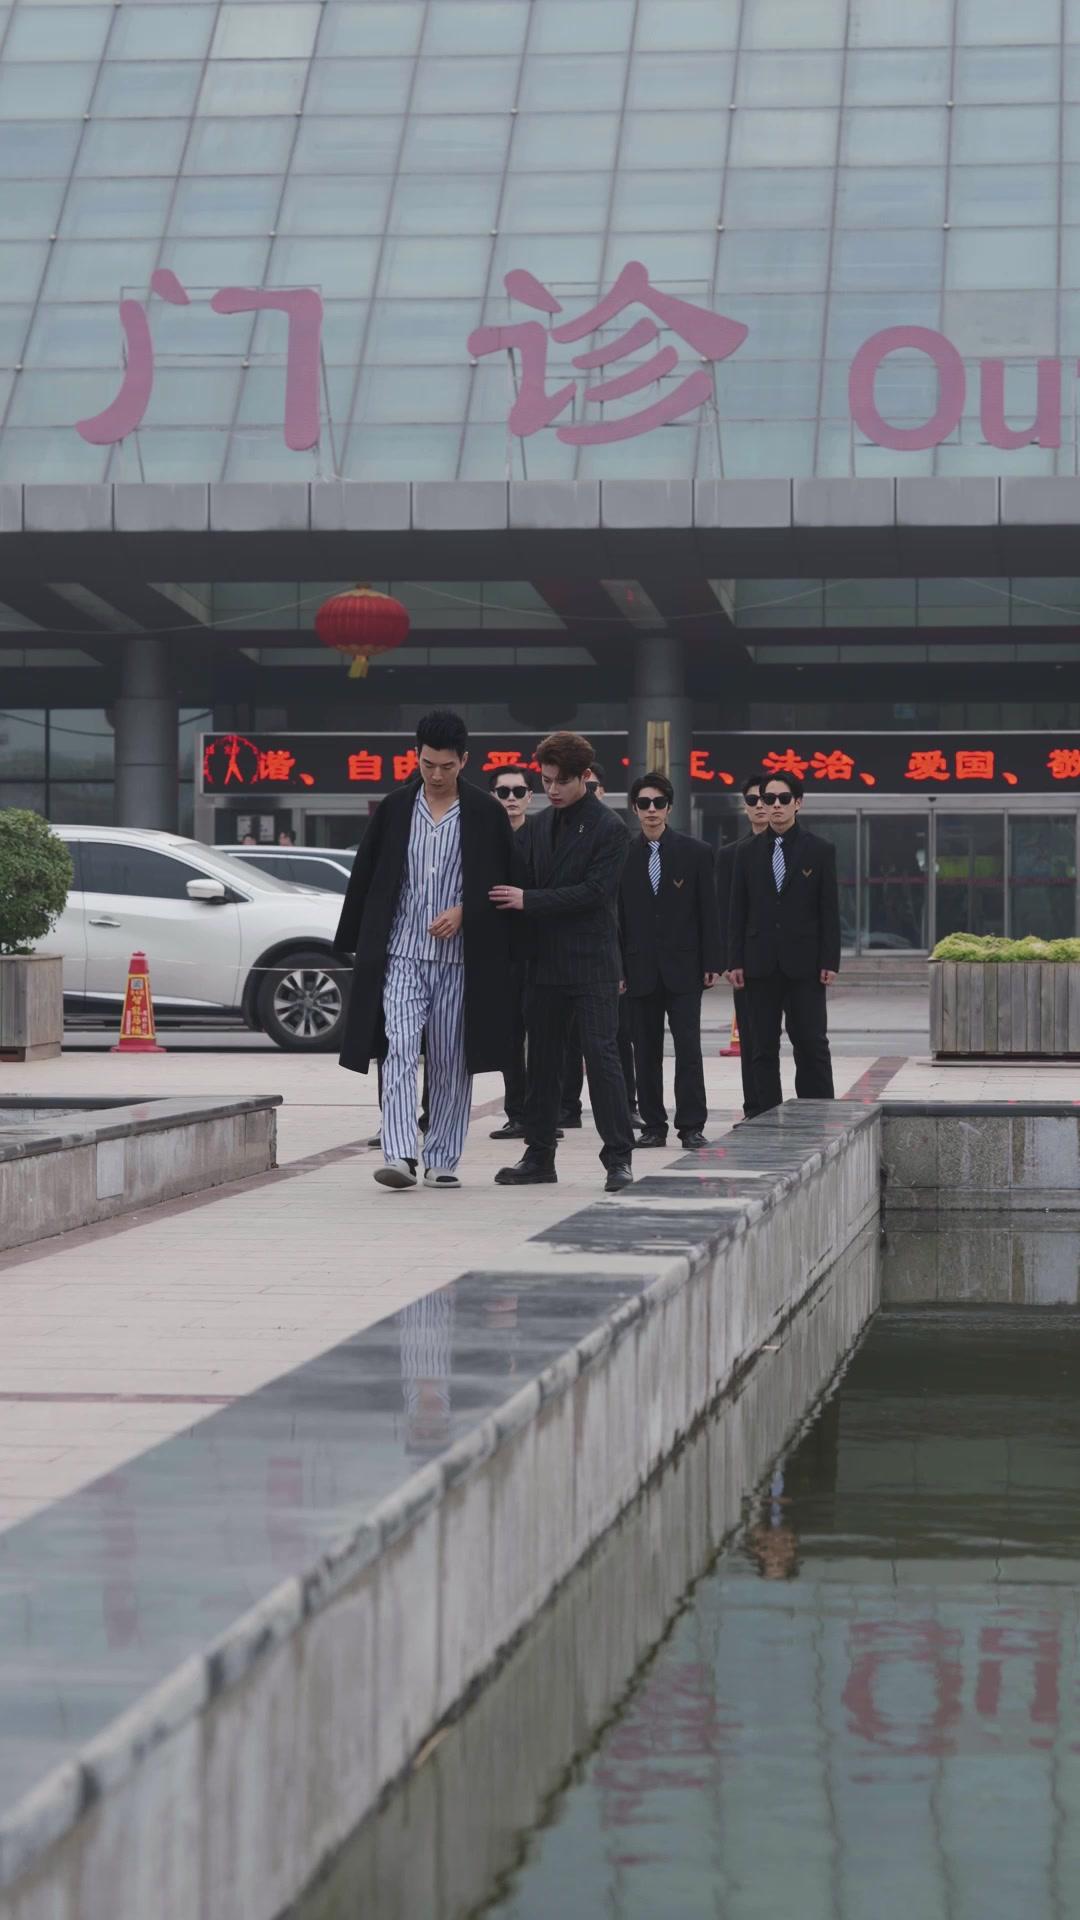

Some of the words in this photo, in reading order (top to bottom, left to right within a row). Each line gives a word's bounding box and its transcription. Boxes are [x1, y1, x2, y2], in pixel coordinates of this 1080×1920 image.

[76, 261, 749, 451] 门诊
[848, 324, 1080, 451] Ou
[482, 751, 542, 773] 平
